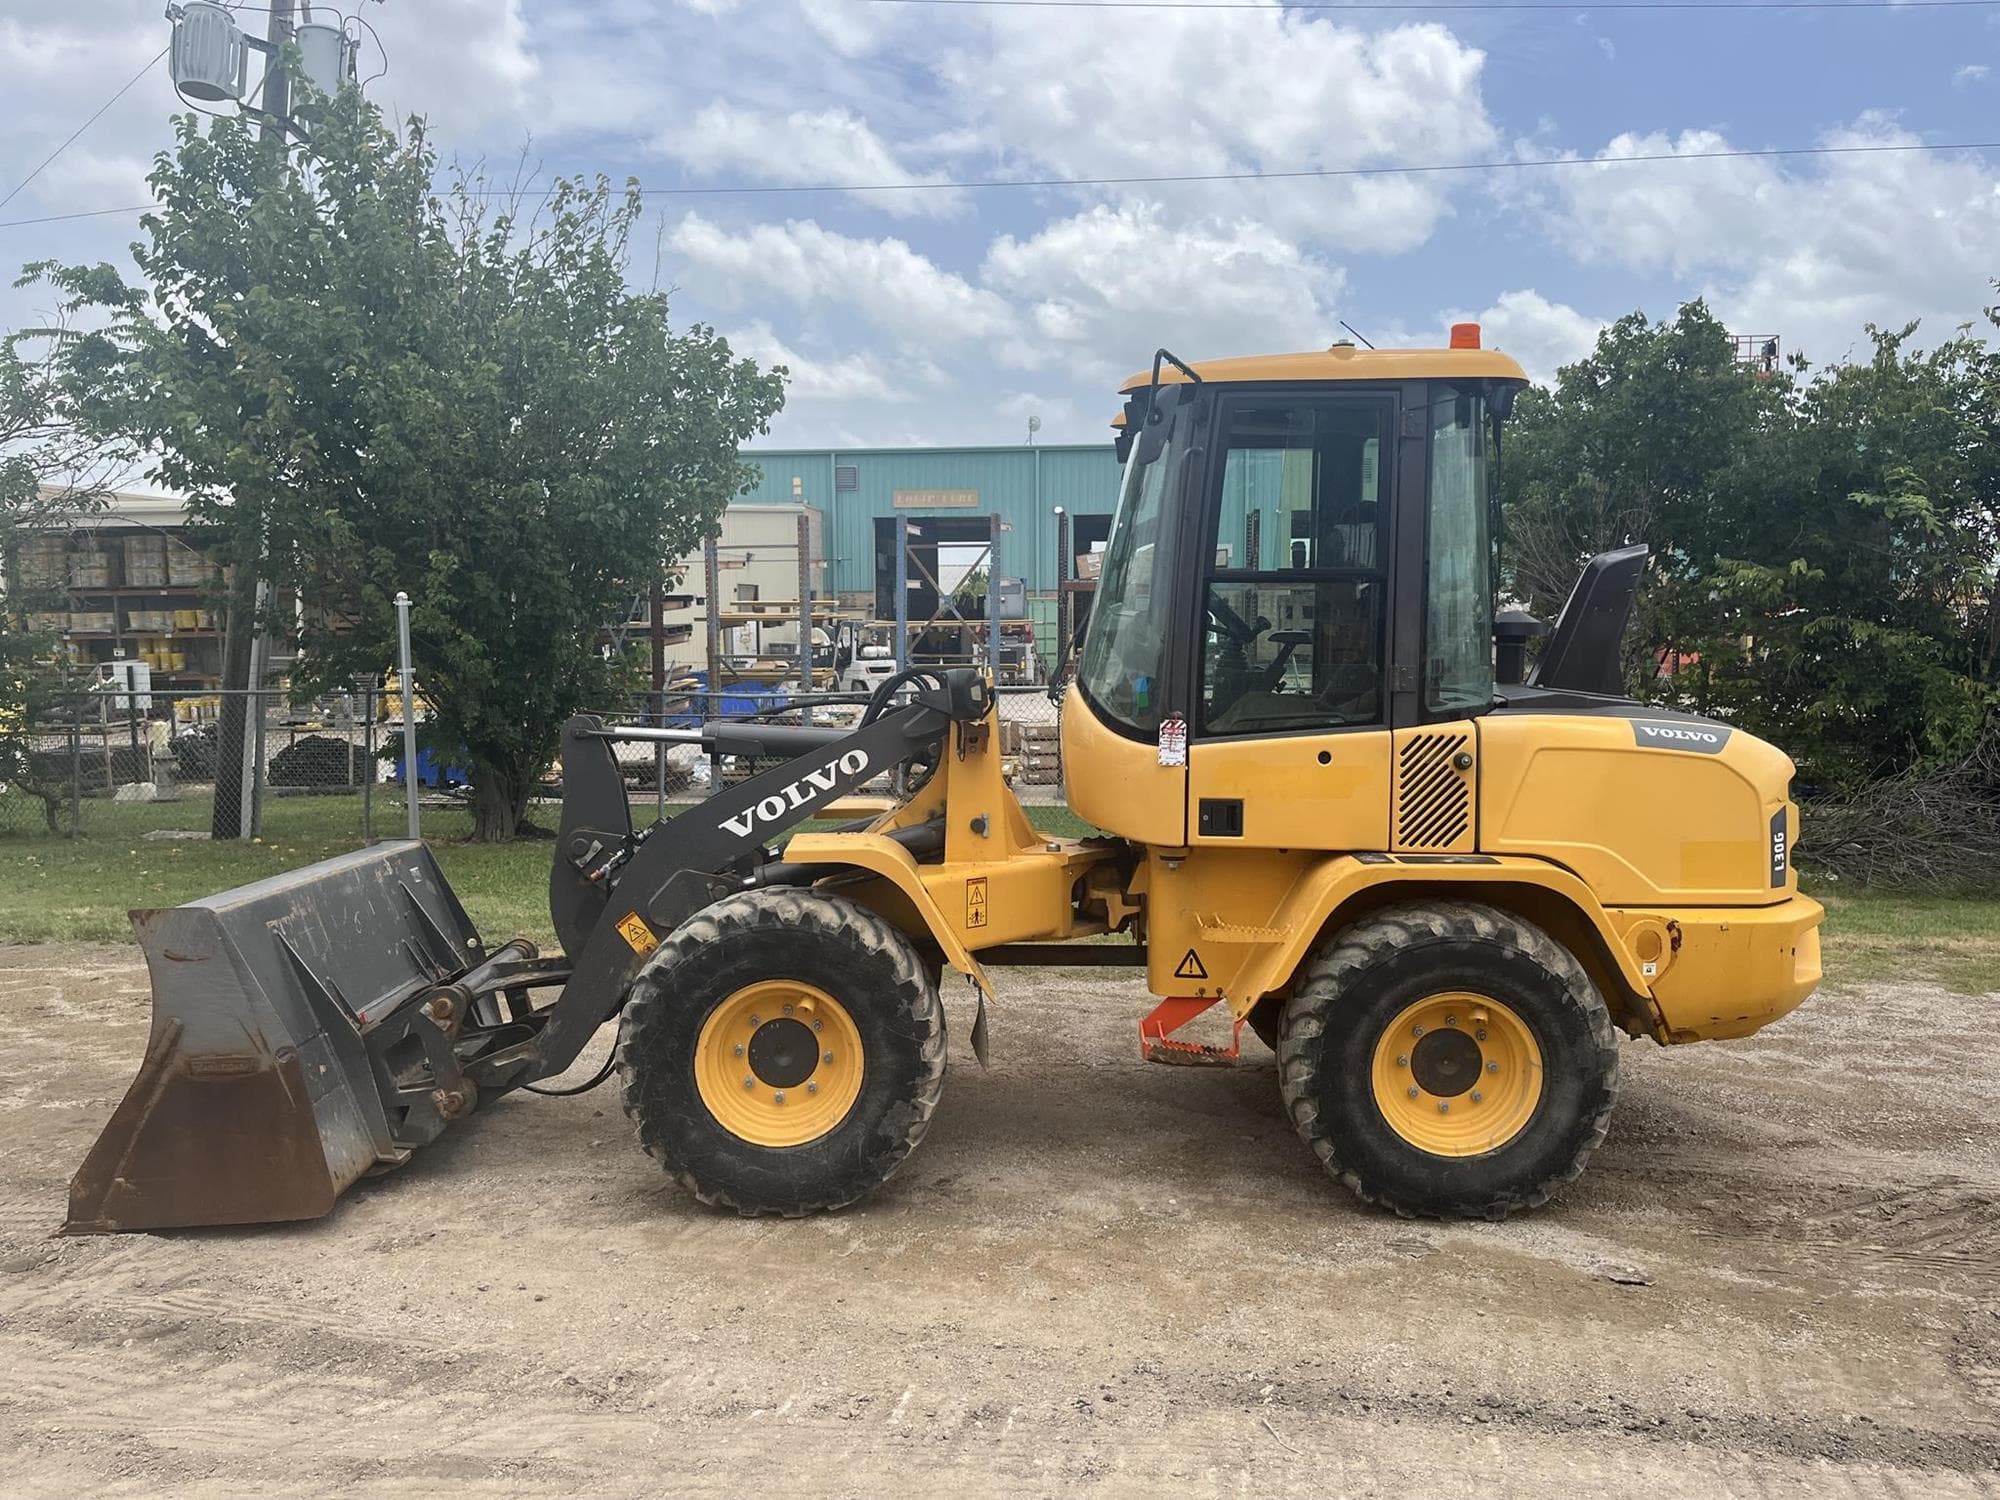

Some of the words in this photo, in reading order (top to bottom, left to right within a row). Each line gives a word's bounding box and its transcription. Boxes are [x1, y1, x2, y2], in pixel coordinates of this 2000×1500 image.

[1640, 726, 1718, 743] VOLVO
[718, 749, 869, 838] VOLVO
[1774, 832, 1784, 871] L30G
